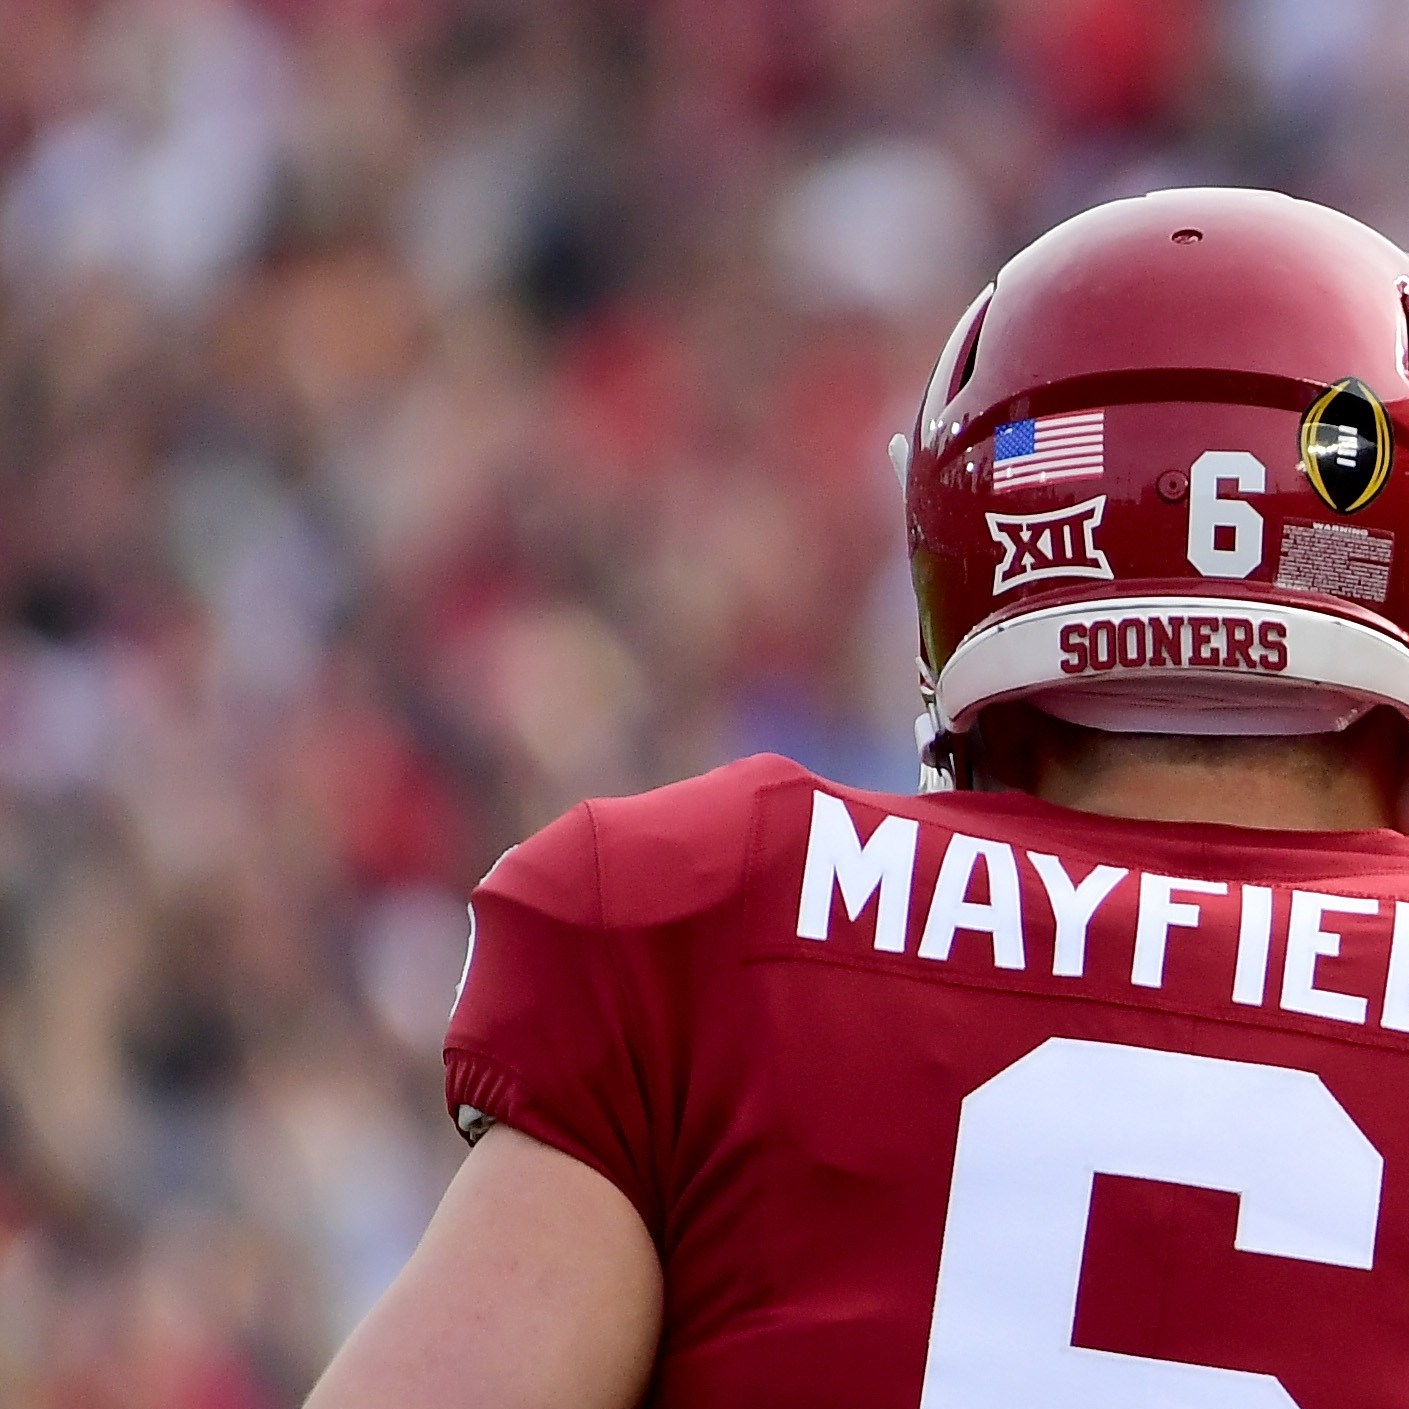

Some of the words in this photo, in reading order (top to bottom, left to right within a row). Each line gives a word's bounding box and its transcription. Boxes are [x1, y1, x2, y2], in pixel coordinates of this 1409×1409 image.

[1187, 450, 1266, 579] 6
[1313, 522, 1369, 536] WARNING
[1060, 616, 1288, 674] SOONERS
